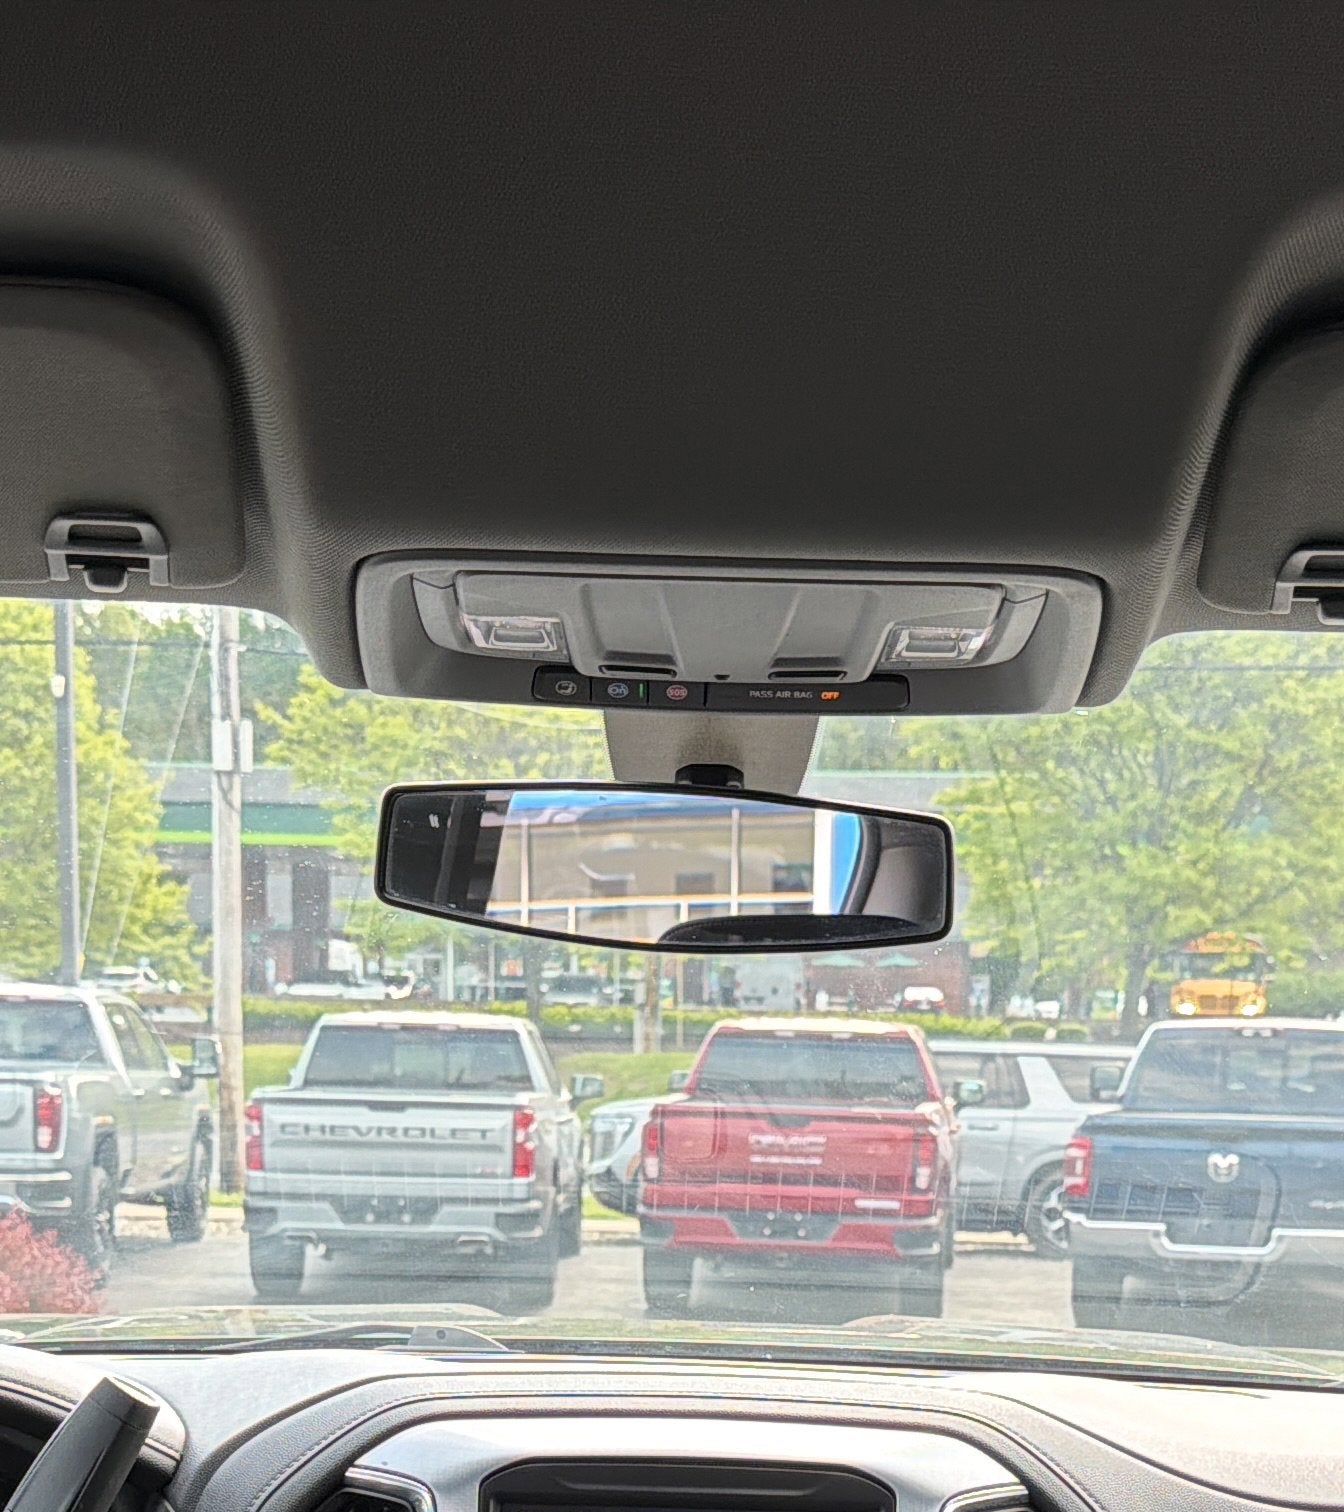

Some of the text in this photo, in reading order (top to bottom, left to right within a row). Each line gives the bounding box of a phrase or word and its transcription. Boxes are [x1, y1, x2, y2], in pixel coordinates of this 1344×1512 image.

[750, 690, 773, 698] PASS
[794, 691, 813, 699] BAG
[820, 691, 840, 699] OFF
[280, 1123, 496, 1140] CHEVROLET
